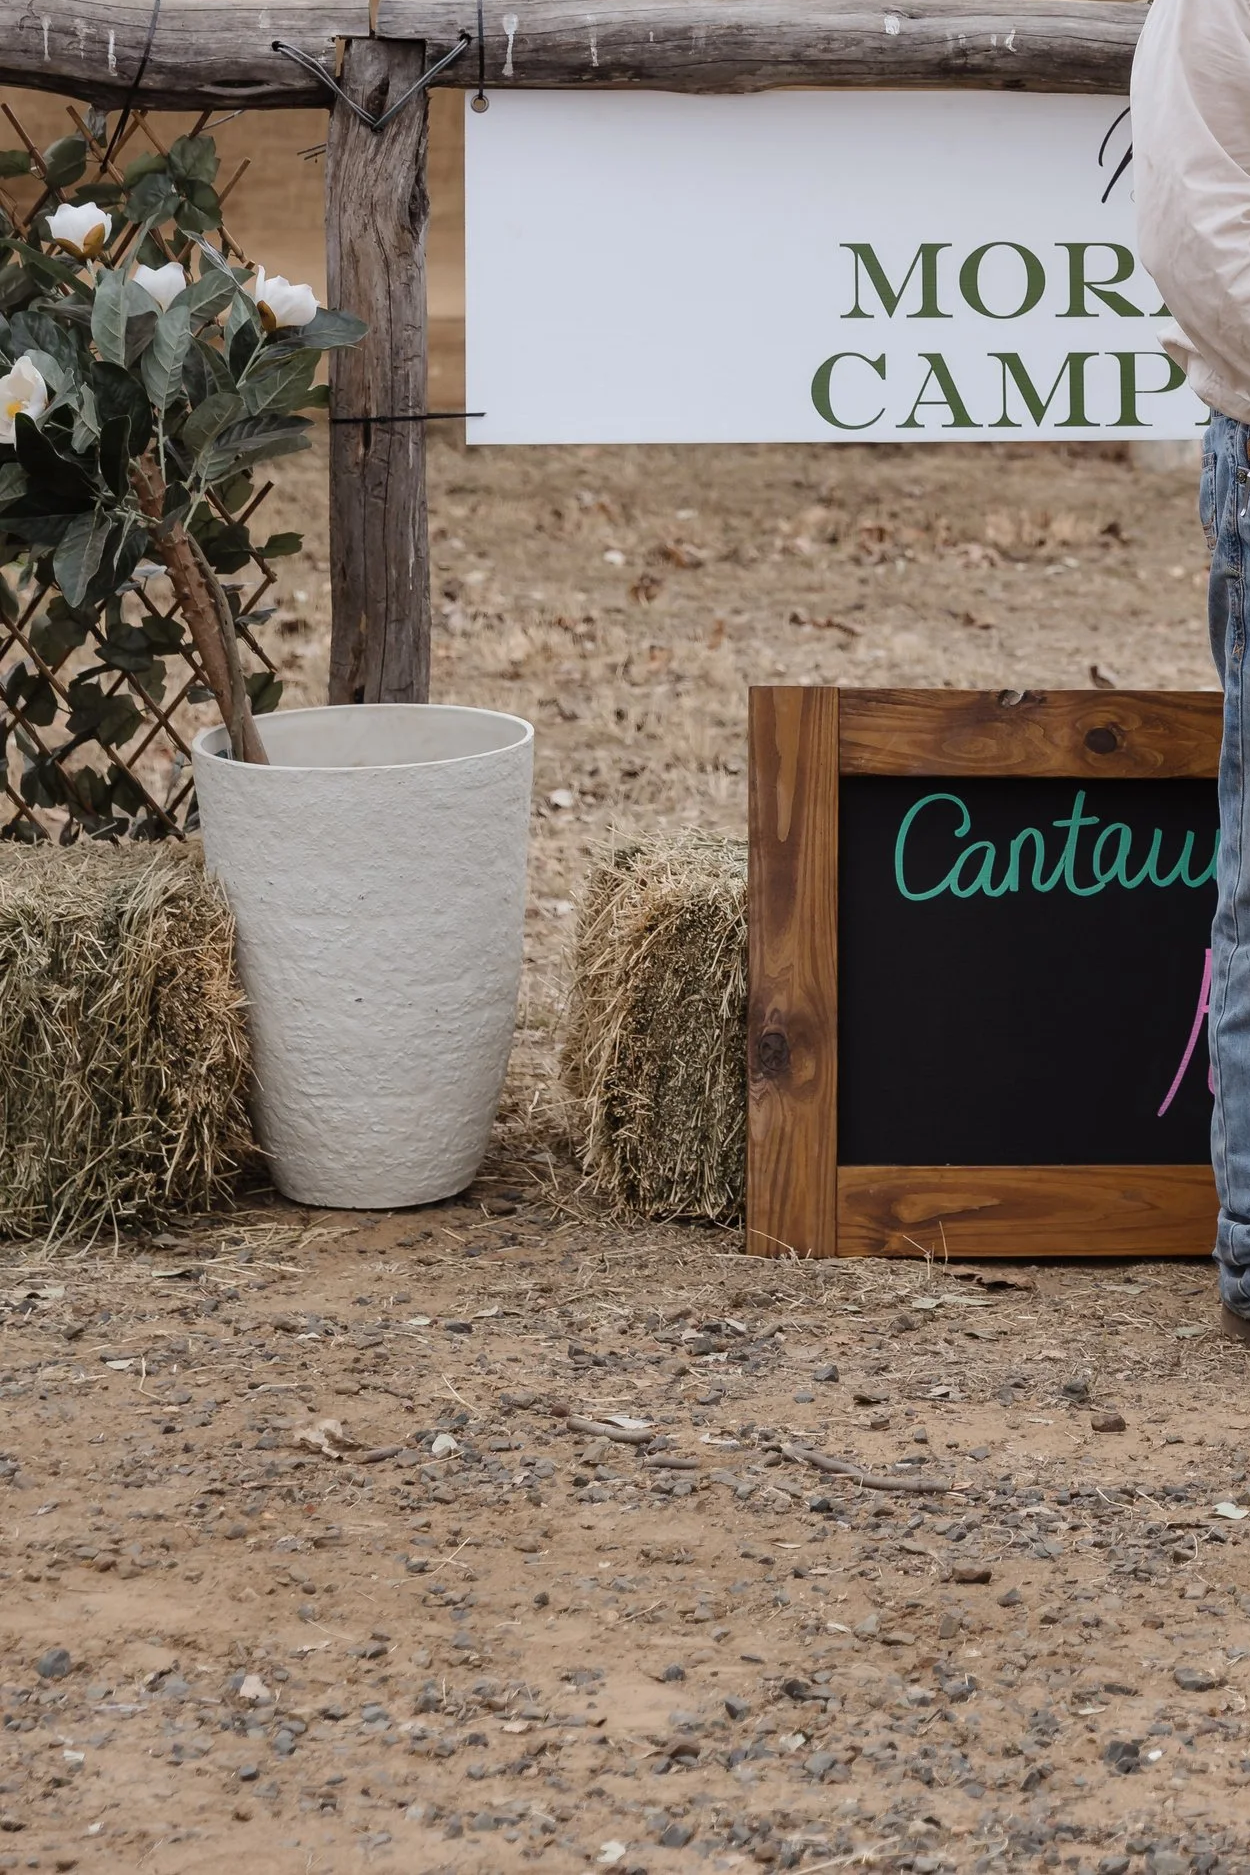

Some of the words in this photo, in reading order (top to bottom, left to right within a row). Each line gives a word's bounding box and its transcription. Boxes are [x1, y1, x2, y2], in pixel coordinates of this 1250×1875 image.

[838, 241, 1174, 319] MOR
[810, 351, 1211, 431] CAMP
[894, 789, 1221, 902] Cantau
